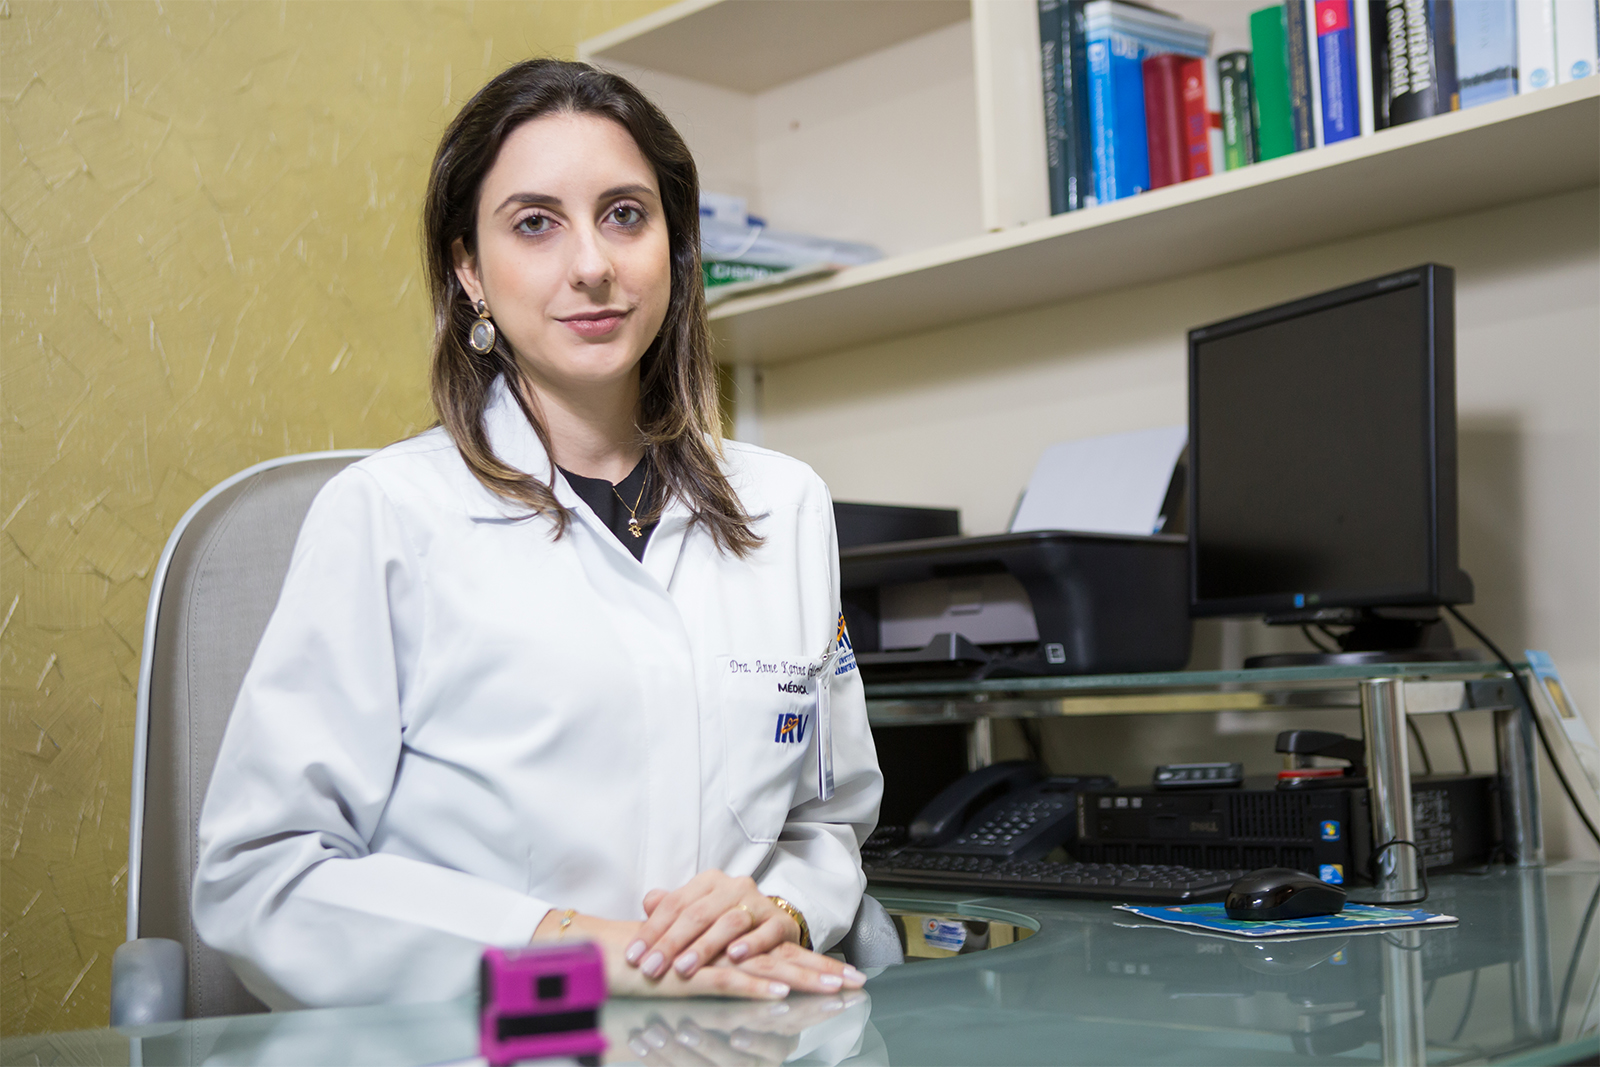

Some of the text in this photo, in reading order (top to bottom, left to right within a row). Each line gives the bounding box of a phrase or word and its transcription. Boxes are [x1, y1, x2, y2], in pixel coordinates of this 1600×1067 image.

[729, 659, 751, 673] Dra.
[755, 659, 778, 674] Anne
[774, 712, 809, 743] IRV
